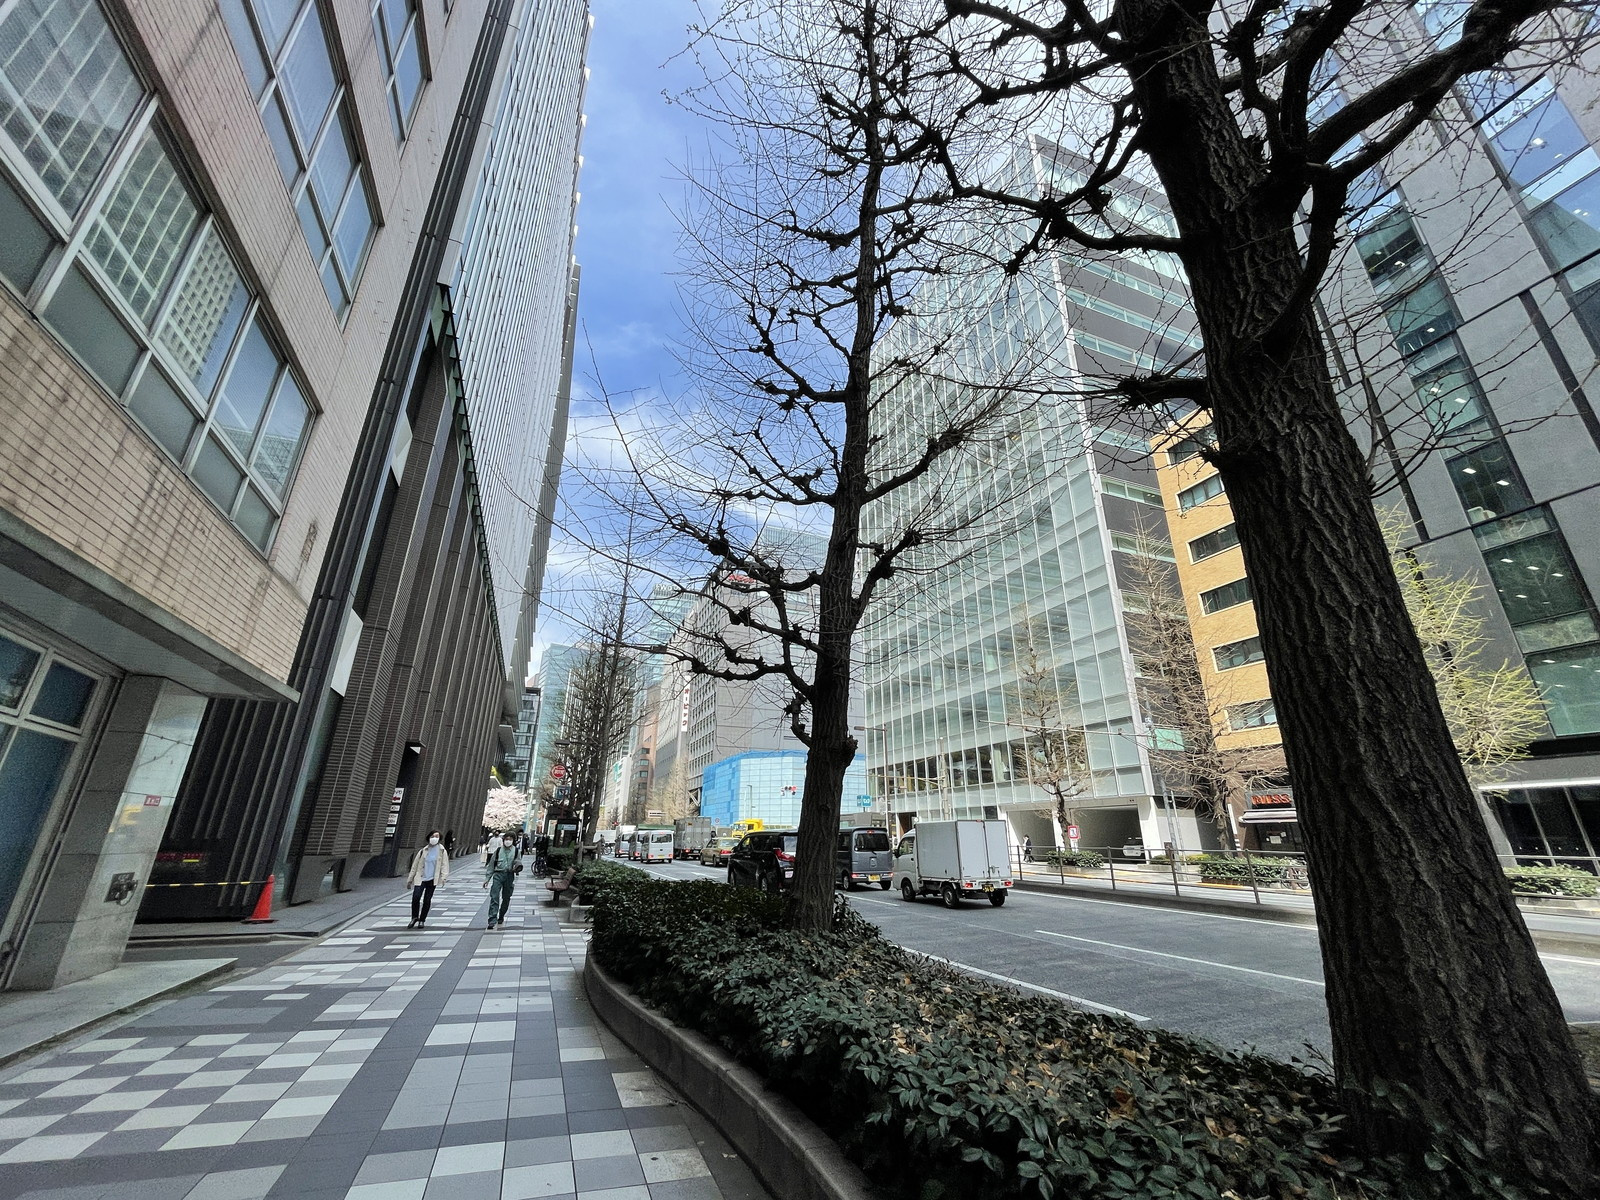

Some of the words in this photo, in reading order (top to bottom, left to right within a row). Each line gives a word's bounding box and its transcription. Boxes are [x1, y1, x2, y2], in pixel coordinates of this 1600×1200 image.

[682, 688, 690, 726] オービック
